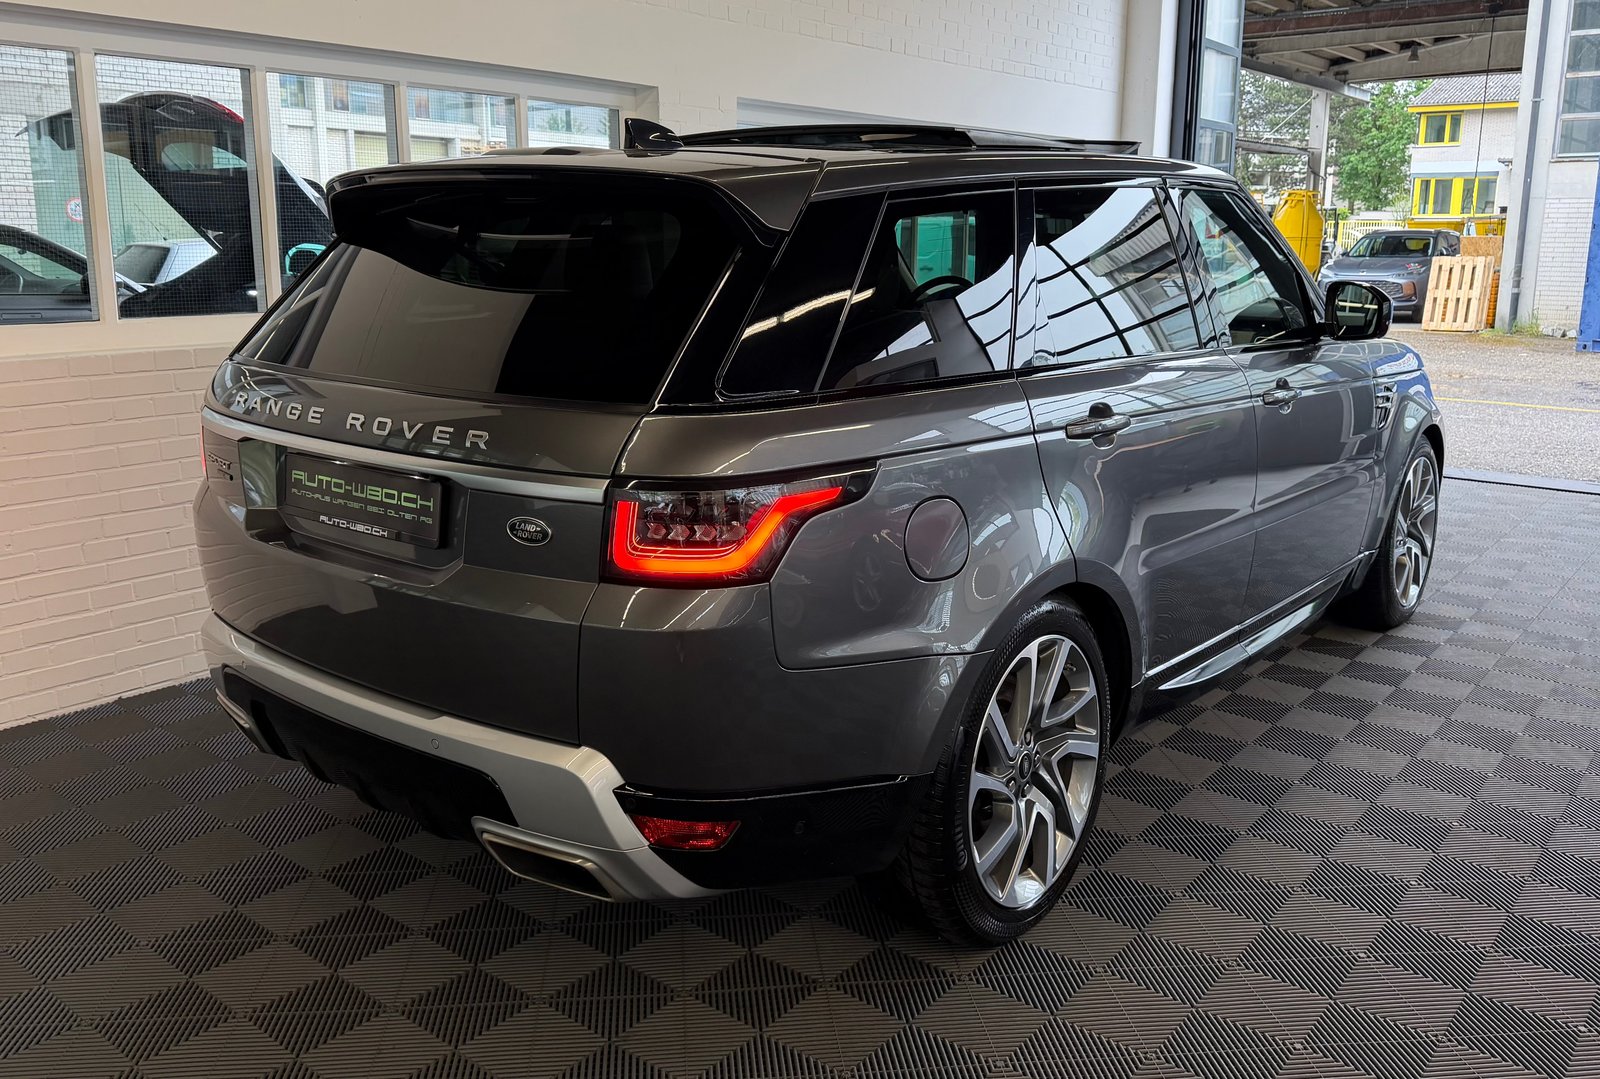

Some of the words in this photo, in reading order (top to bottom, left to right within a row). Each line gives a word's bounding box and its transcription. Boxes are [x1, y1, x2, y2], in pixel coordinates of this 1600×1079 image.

[235, 391, 325, 424] RANGE
[346, 412, 490, 450] ROVER
[515, 521, 537, 532] LAND
[517, 529, 543, 541] ROVER
